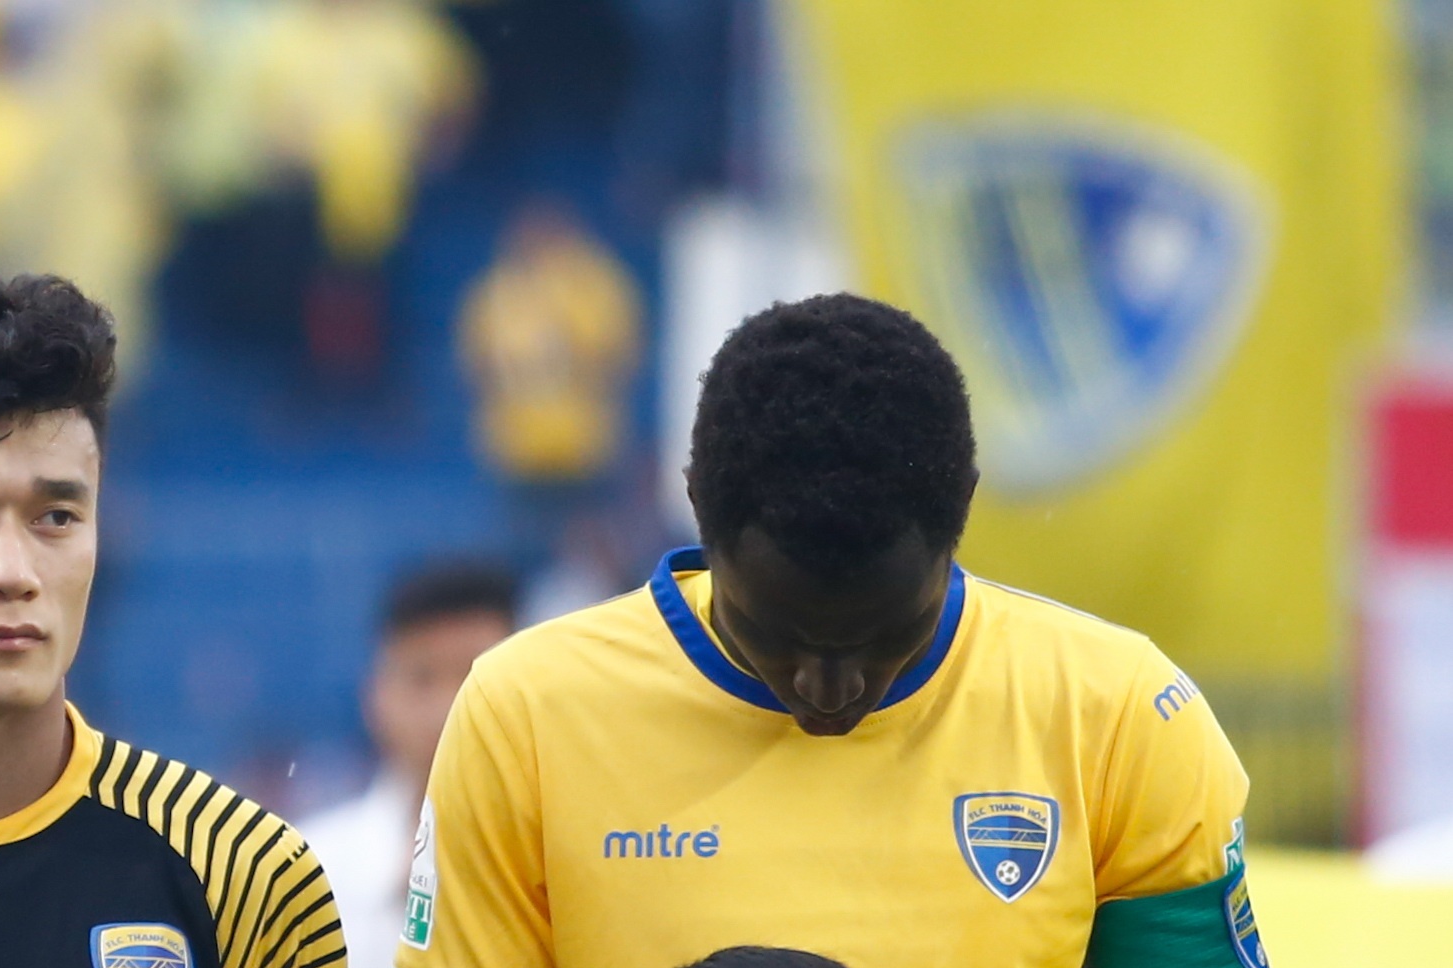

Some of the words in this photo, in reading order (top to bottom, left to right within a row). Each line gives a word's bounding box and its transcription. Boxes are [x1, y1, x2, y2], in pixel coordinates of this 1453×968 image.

[989, 804, 1024, 813] THANH
[604, 823, 719, 858] mitre
[127, 934, 164, 943] THANH
